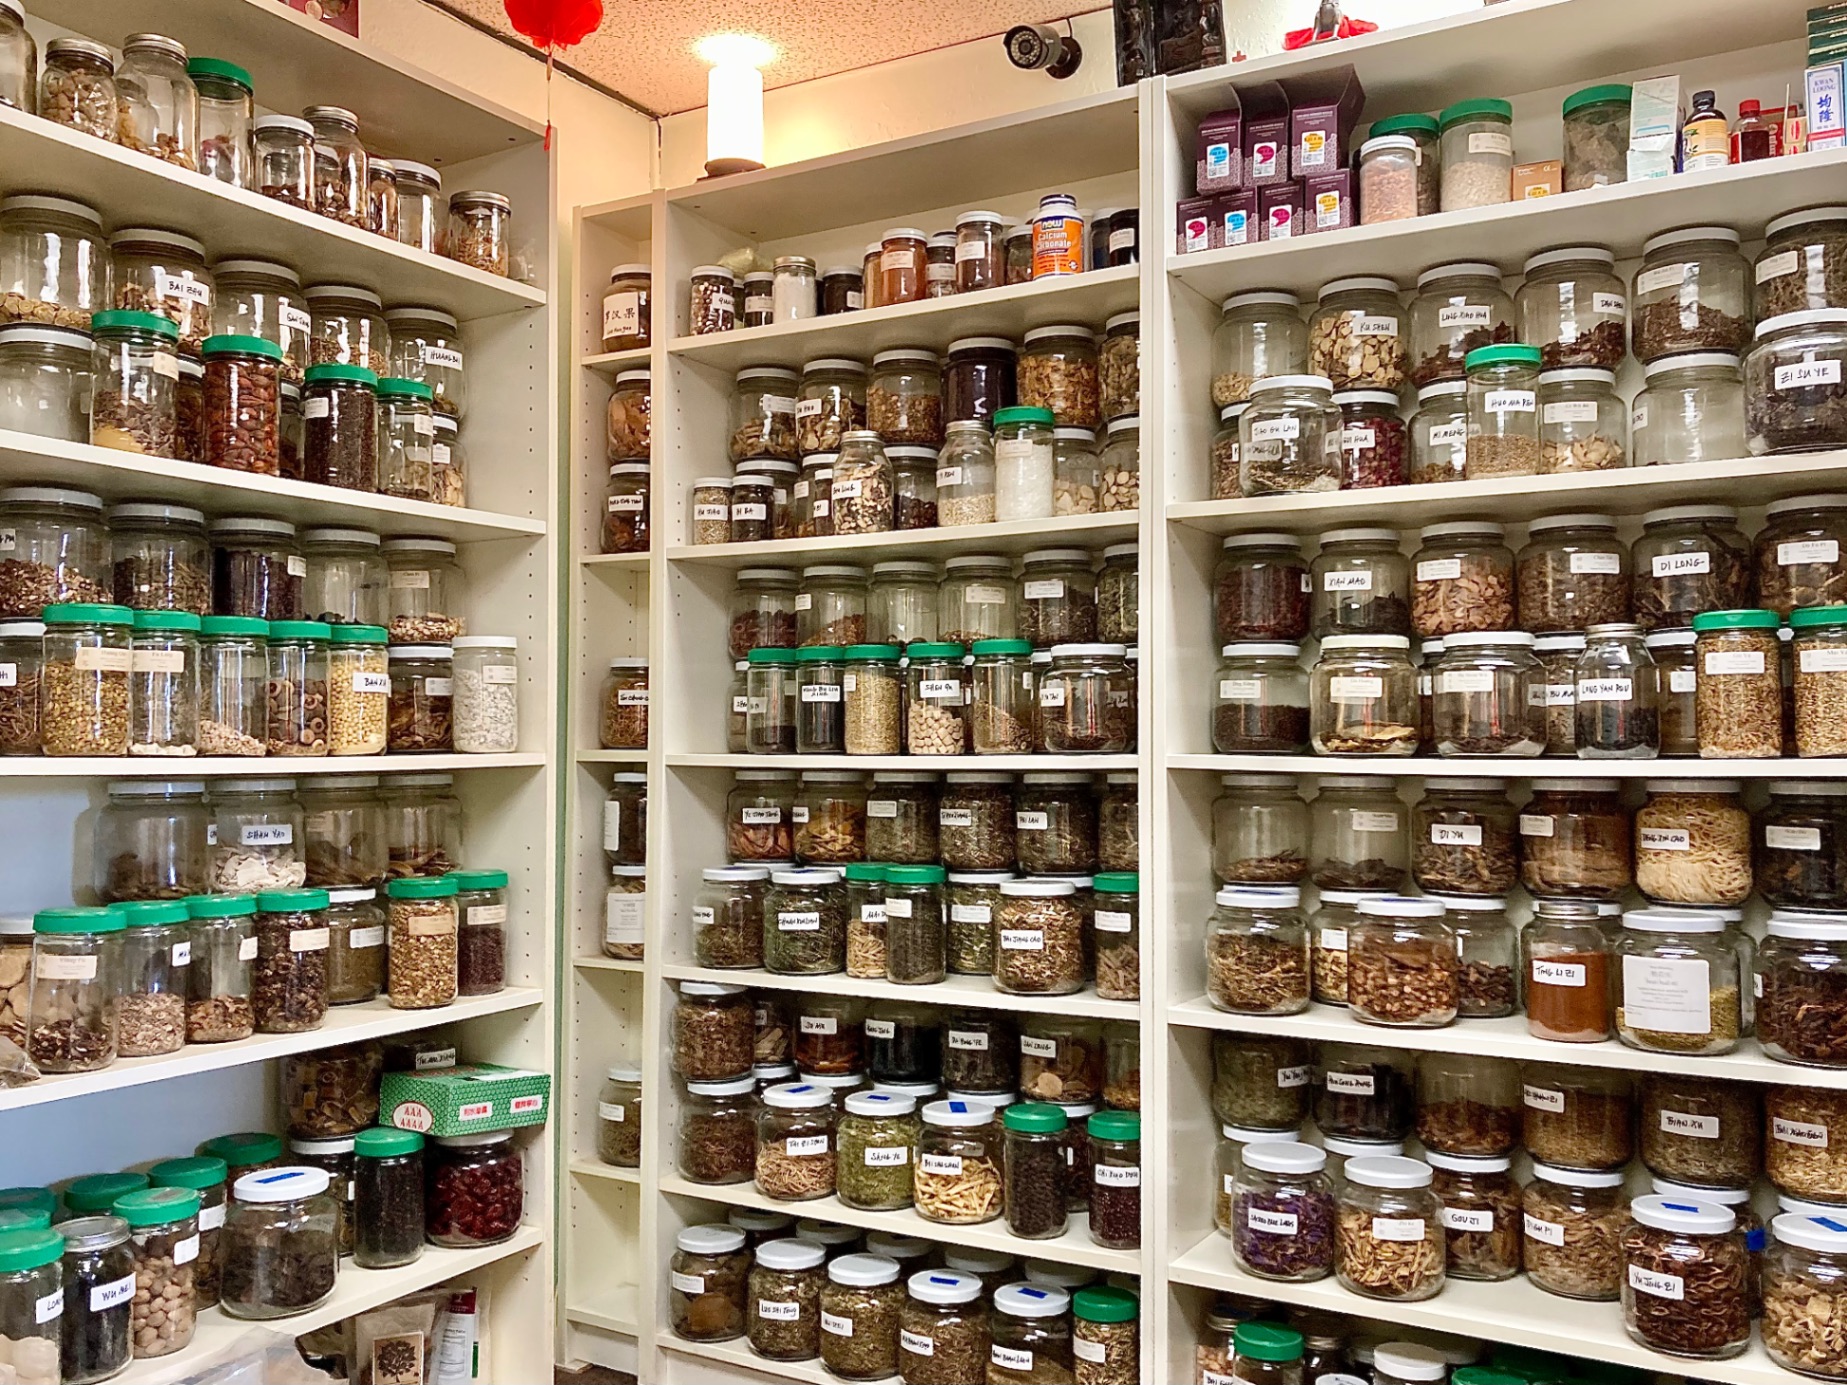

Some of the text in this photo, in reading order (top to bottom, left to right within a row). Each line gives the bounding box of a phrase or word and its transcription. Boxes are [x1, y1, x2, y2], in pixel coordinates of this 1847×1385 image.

[1814, 78, 1834, 86] KWAN
[1812, 84, 1836, 94] LOONG
[1660, 557, 1705, 571] DI LONG
